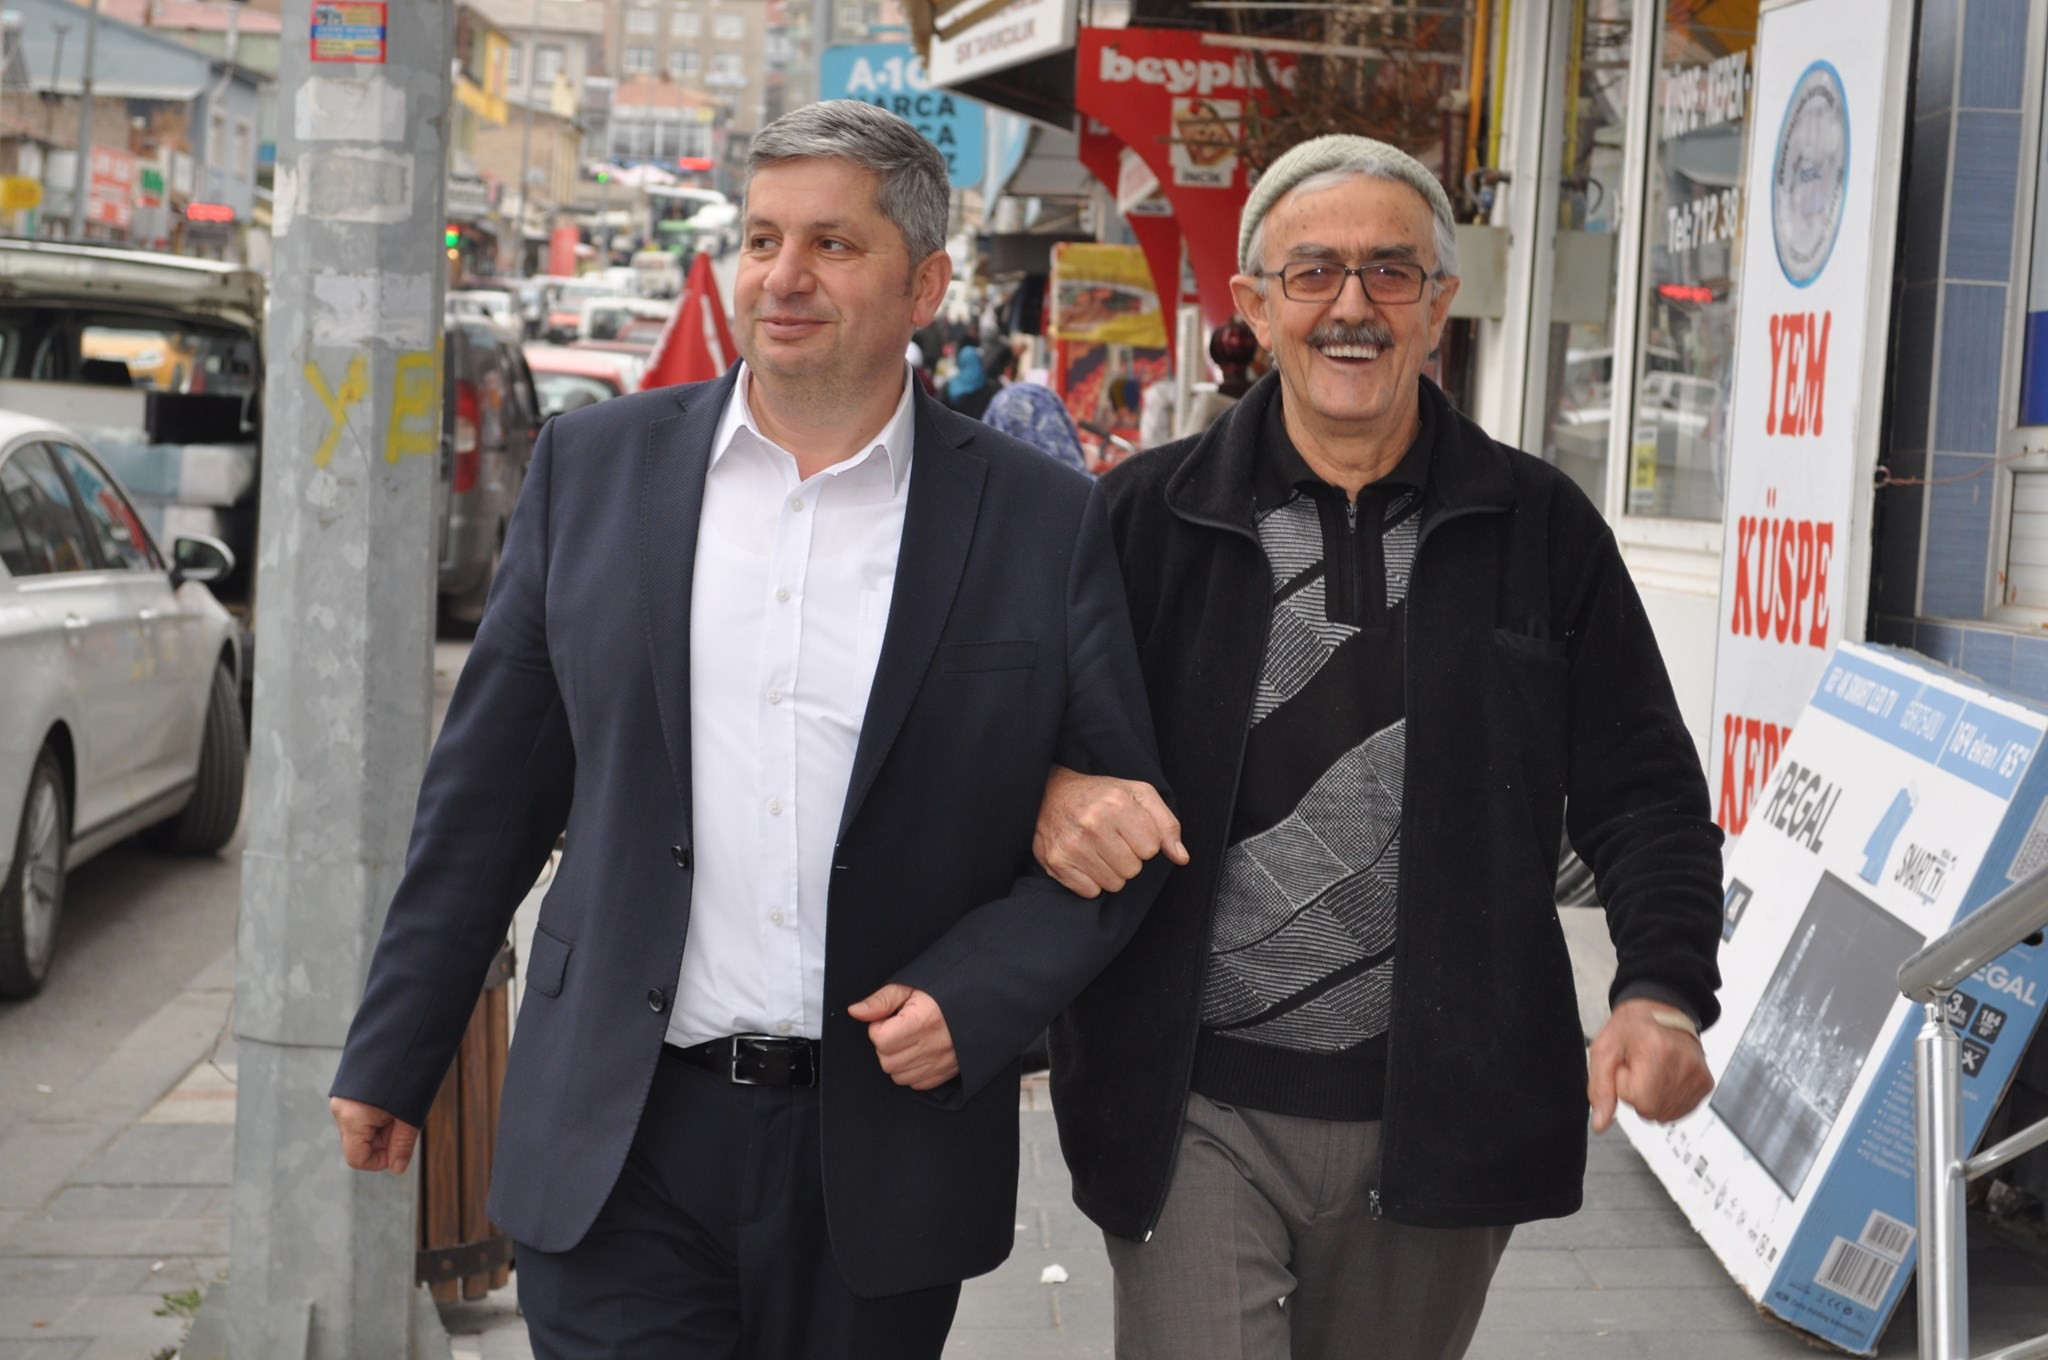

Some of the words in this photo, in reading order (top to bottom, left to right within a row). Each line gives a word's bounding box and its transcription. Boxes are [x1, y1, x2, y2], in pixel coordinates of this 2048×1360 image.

[1766, 310, 1832, 438] YEM
[1731, 486, 1834, 652] KÜSPE
[1715, 713, 1793, 837] KEP
[1967, 732, 1999, 769] ekran
[1763, 760, 1843, 855] REGAL
[1894, 843, 1938, 896] SMART
[1926, 866, 1945, 895] TV
[1947, 993, 1963, 1014] 3
[1980, 1009, 2002, 1028] 164
